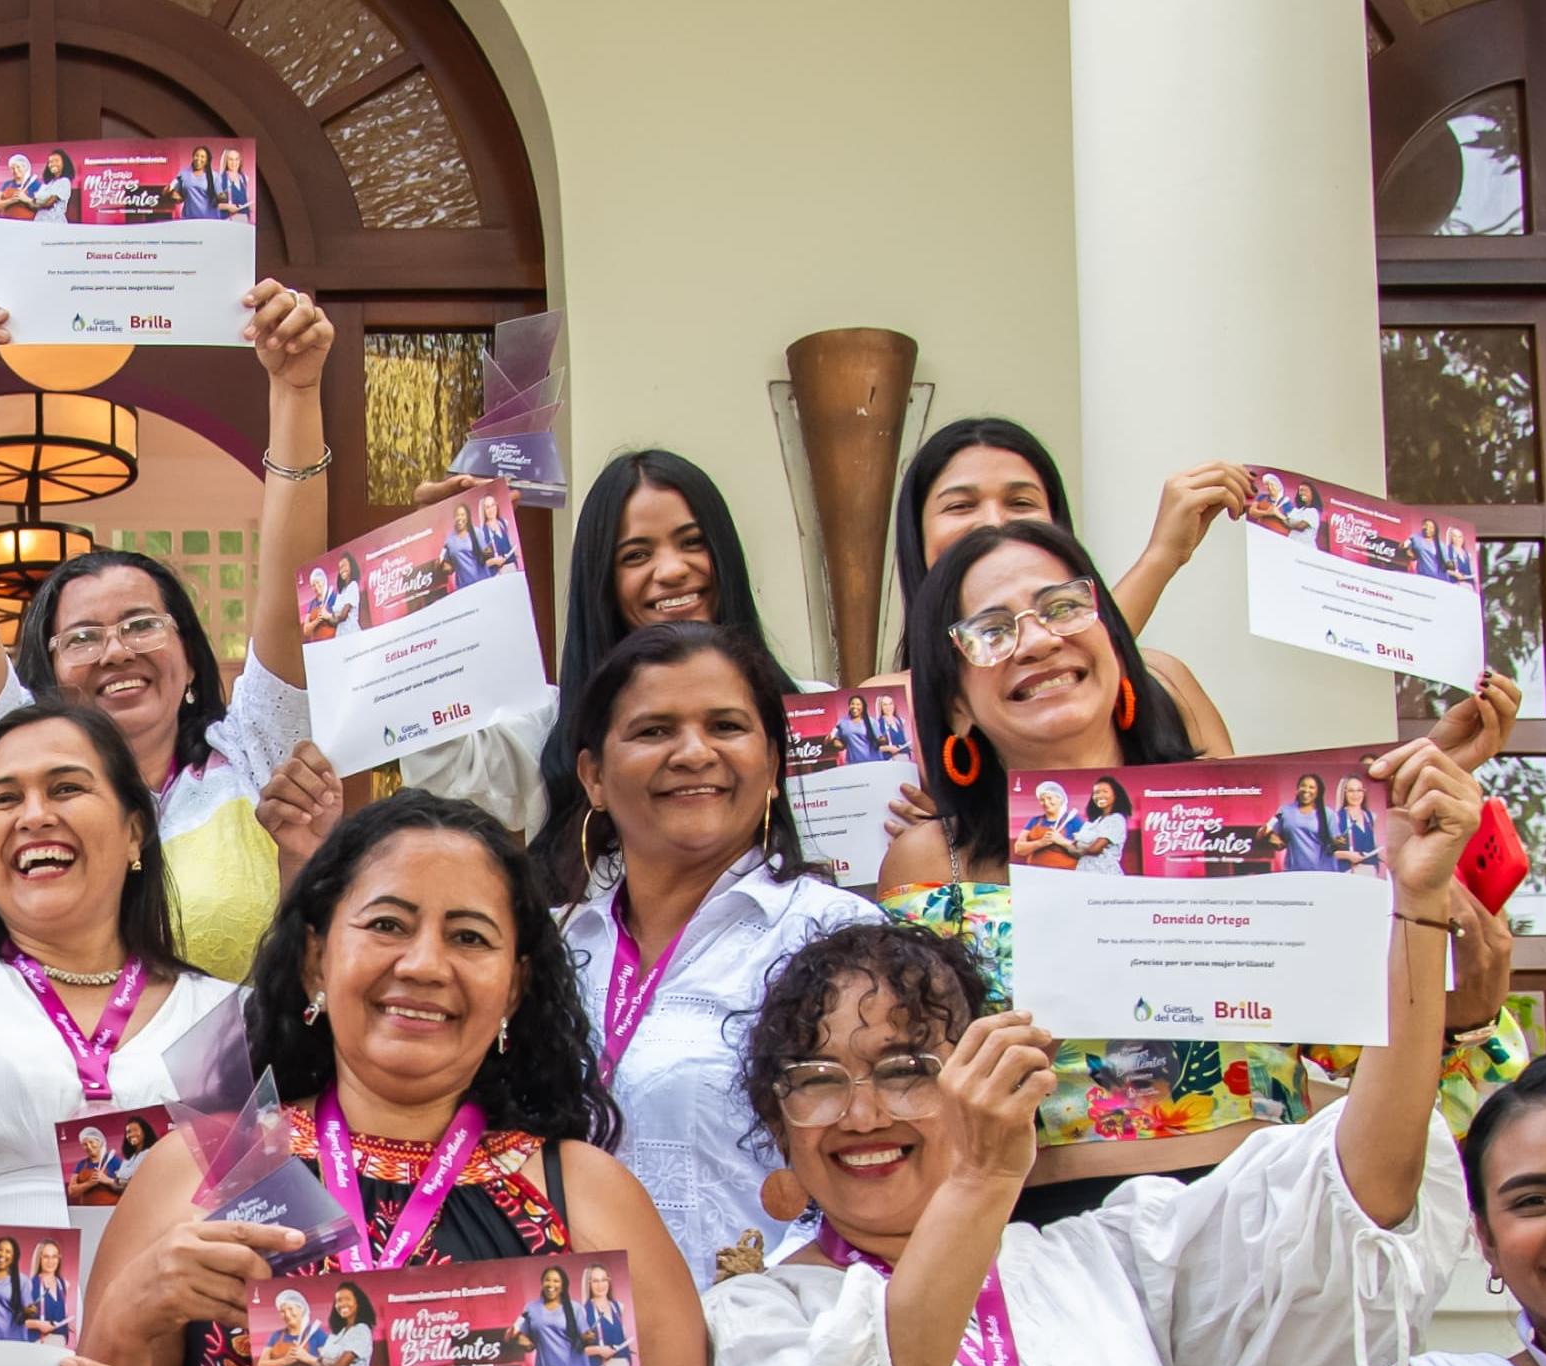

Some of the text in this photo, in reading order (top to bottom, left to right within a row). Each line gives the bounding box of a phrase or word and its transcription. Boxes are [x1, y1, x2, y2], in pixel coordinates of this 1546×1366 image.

[84, 175, 139, 193] Mujeres
[90, 190, 159, 208] Brillantes
[131, 315, 172, 329] Brilla
[1336, 529, 1396, 557] Brillantes
[368, 560, 413, 590] Mujeres
[375, 571, 433, 607] Brillantes
[1377, 643, 1413, 662] Brilla
[432, 703, 471, 726] Brilla
[1172, 804, 1213, 819] Premio
[1145, 811, 1224, 838] Mujeres
[1153, 831, 1252, 856] Brillantes
[1153, 914, 1250, 927] Daneida Ortega
[1164, 1004, 1193, 1013] Gases
[1215, 1001, 1272, 1019] Brilla
[1154, 1014, 1204, 1024] del Caribe
[417, 1309, 459, 1325] Premio
[391, 1319, 470, 1346] Mujeres
[401, 1337, 500, 1366] Brillantes
